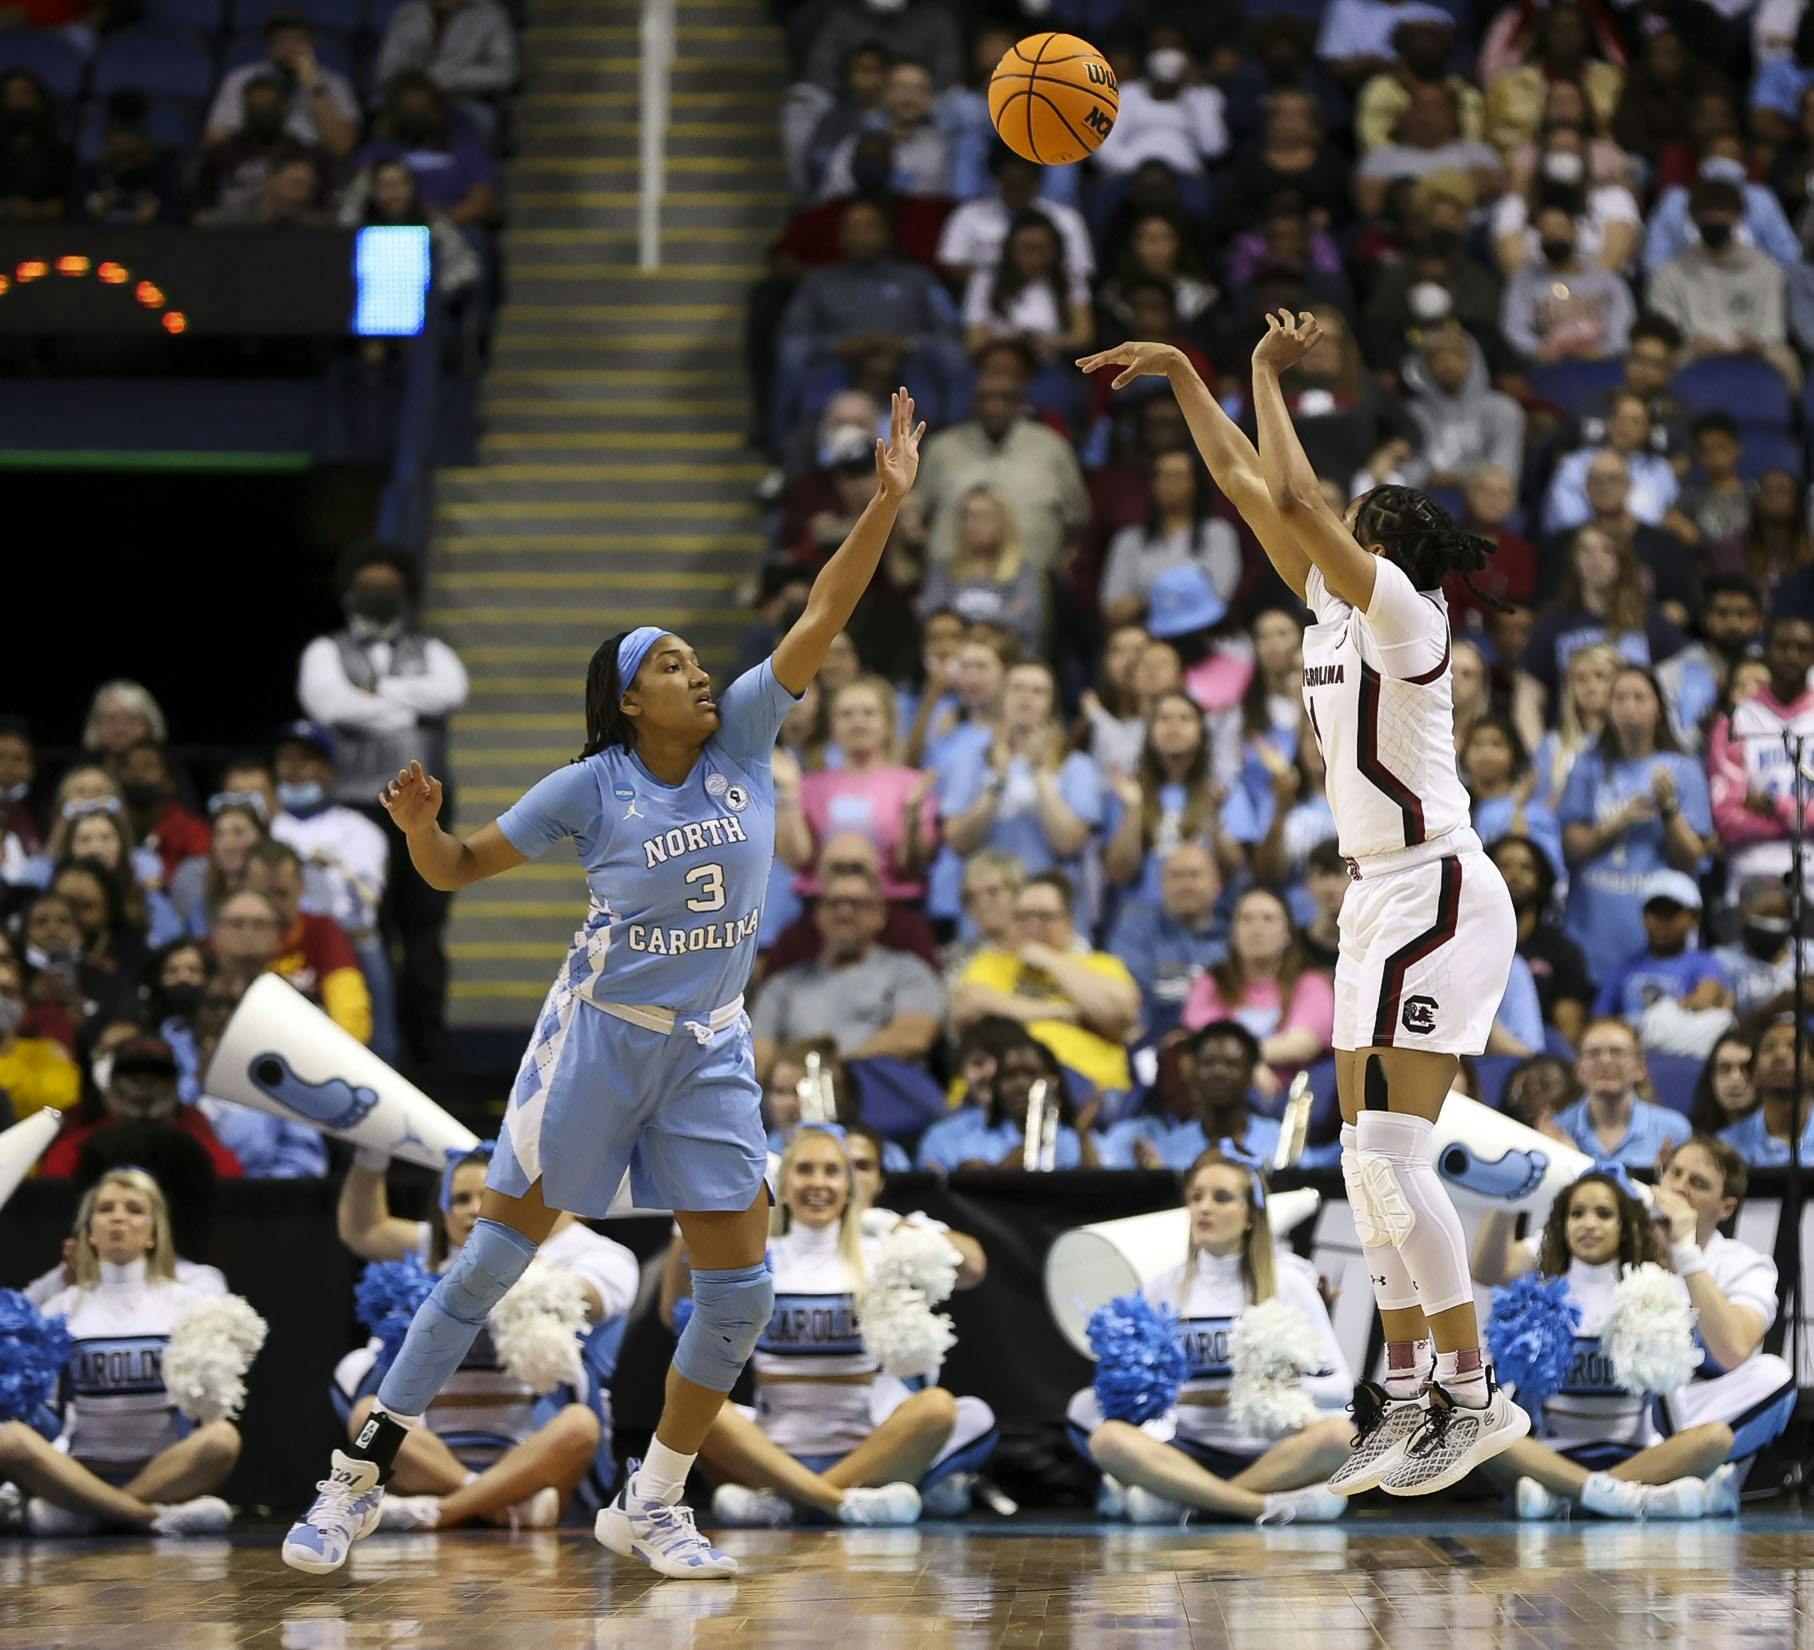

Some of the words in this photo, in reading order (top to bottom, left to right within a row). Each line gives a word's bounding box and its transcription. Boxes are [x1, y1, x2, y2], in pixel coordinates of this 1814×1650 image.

[642, 815, 748, 869] NORTH
[685, 862, 727, 913] 3
[628, 906, 759, 956] CAROLINA
